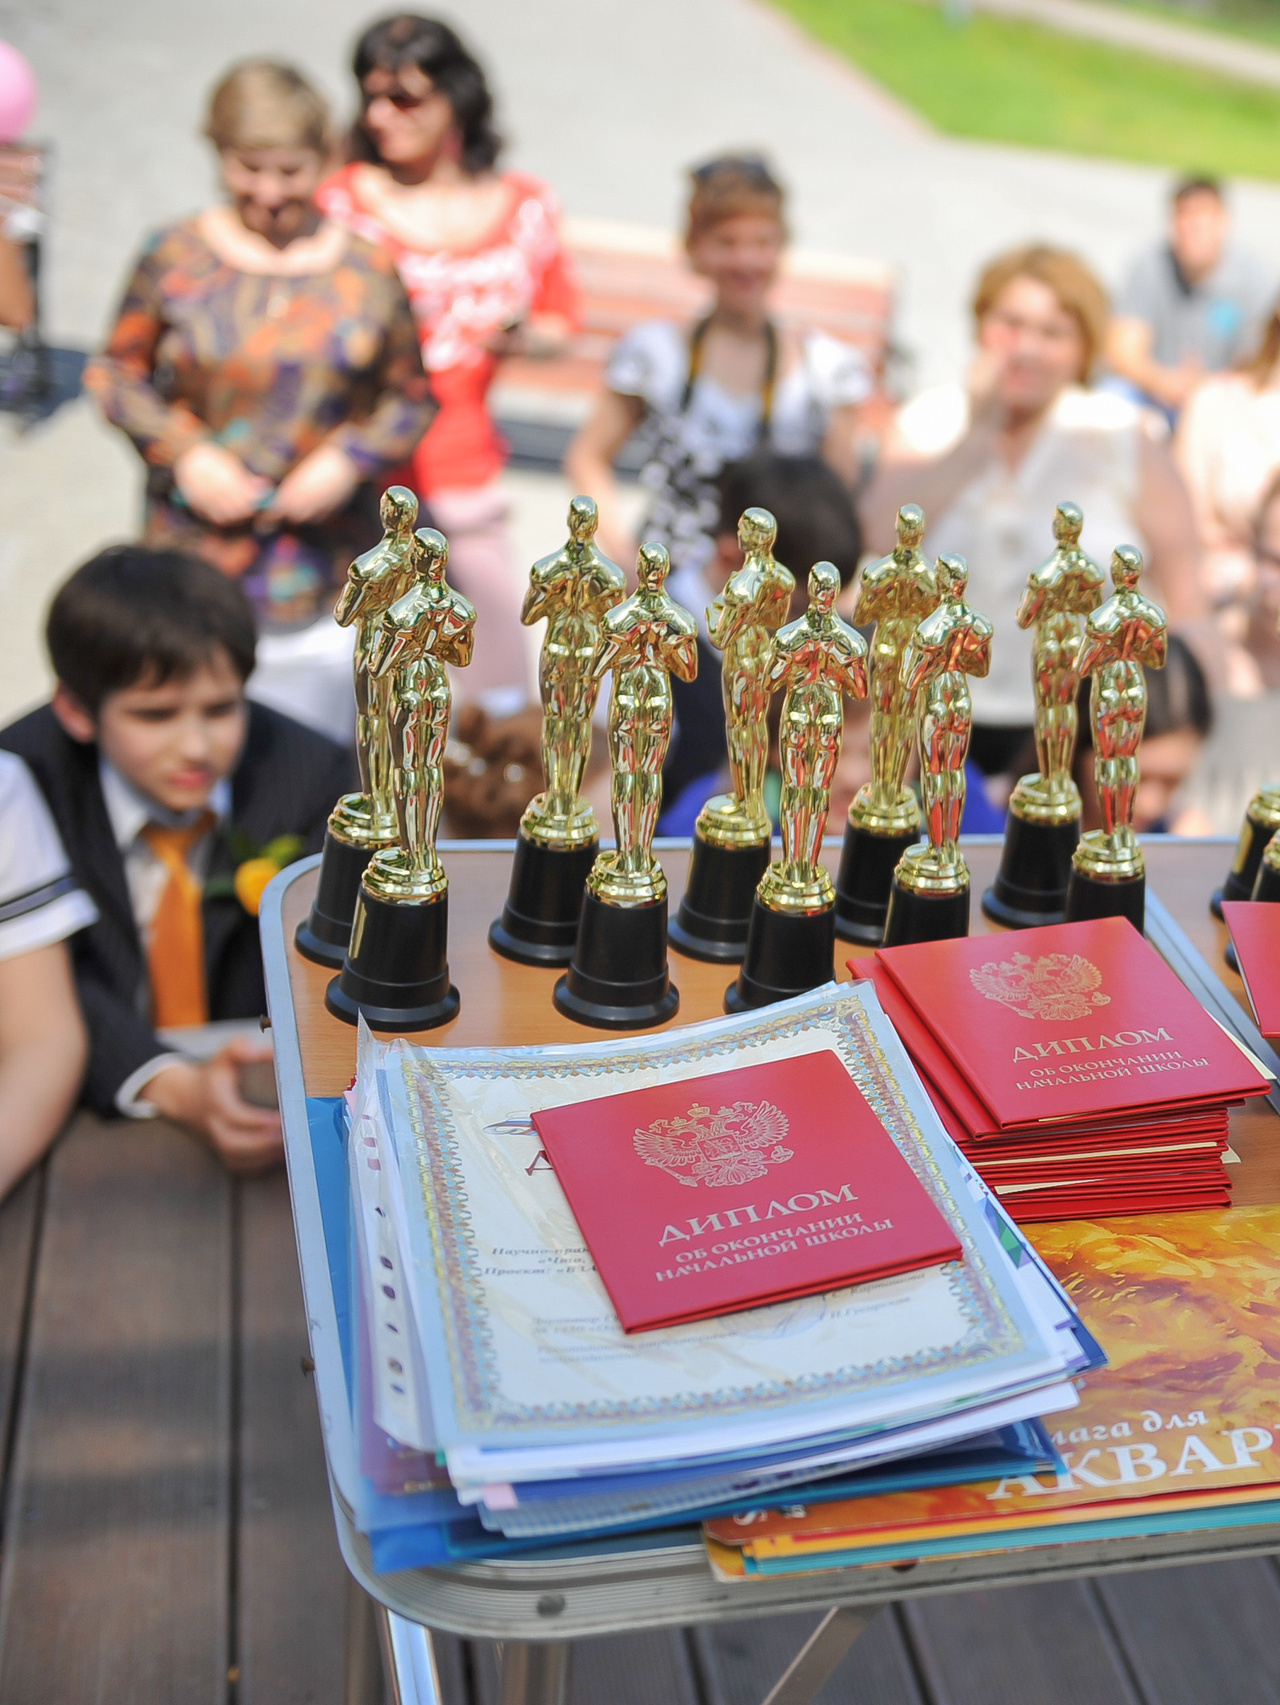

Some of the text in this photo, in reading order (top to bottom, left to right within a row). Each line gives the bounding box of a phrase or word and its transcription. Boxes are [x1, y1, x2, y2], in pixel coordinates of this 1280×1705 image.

[1011, 1026, 1175, 1064] ДИПЛОМ
[1015, 1057, 1211, 1091] НАЧАЛЬНОЙ ШКОЛЫ
[1029, 1050, 1184, 1079] ОБ ОКОНЧАНИИ
[658, 1184, 860, 1248] ДИПЛОМ
[655, 1218, 895, 1282] НАЧАЛЬНОЙ ШКОЛЫ
[675, 1212, 864, 1264] ОБ ОКОНЧАНИИ
[1052, 1409, 1209, 1446] ага для
